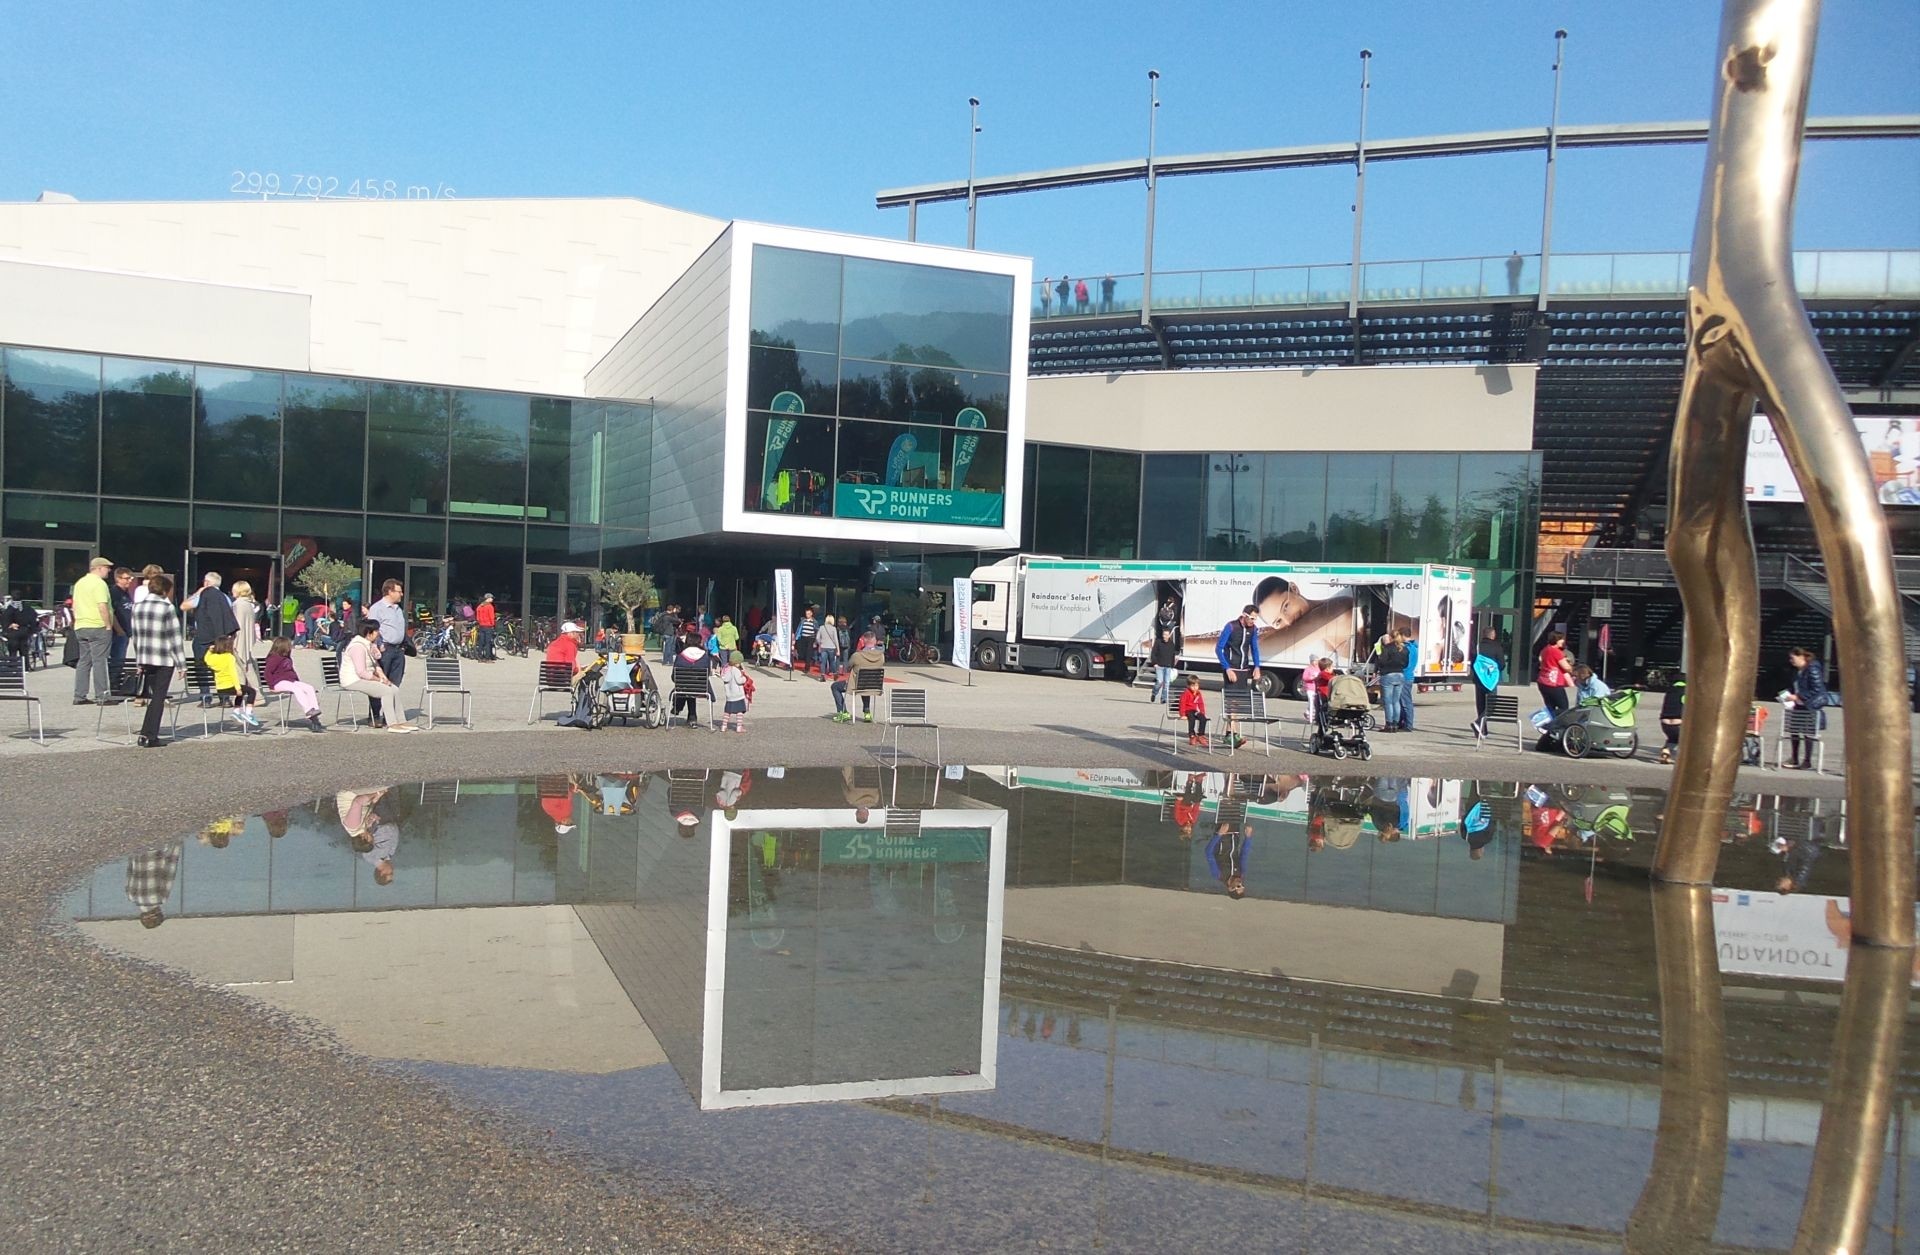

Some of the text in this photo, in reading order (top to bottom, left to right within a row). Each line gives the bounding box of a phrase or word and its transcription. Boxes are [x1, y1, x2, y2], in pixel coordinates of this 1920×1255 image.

[230, 170, 457, 200] 299 792 458 m/s
[890, 490, 953, 506] RUNNERS
[890, 504, 929, 518] POINT
[1200, 577, 1218, 585] auch
[1230, 578, 1254, 586] Ihnen.
[1070, 593, 1091, 601] Select
[1031, 602, 1049, 610] Freude
[1060, 604, 1090, 612] Knopfdruck
